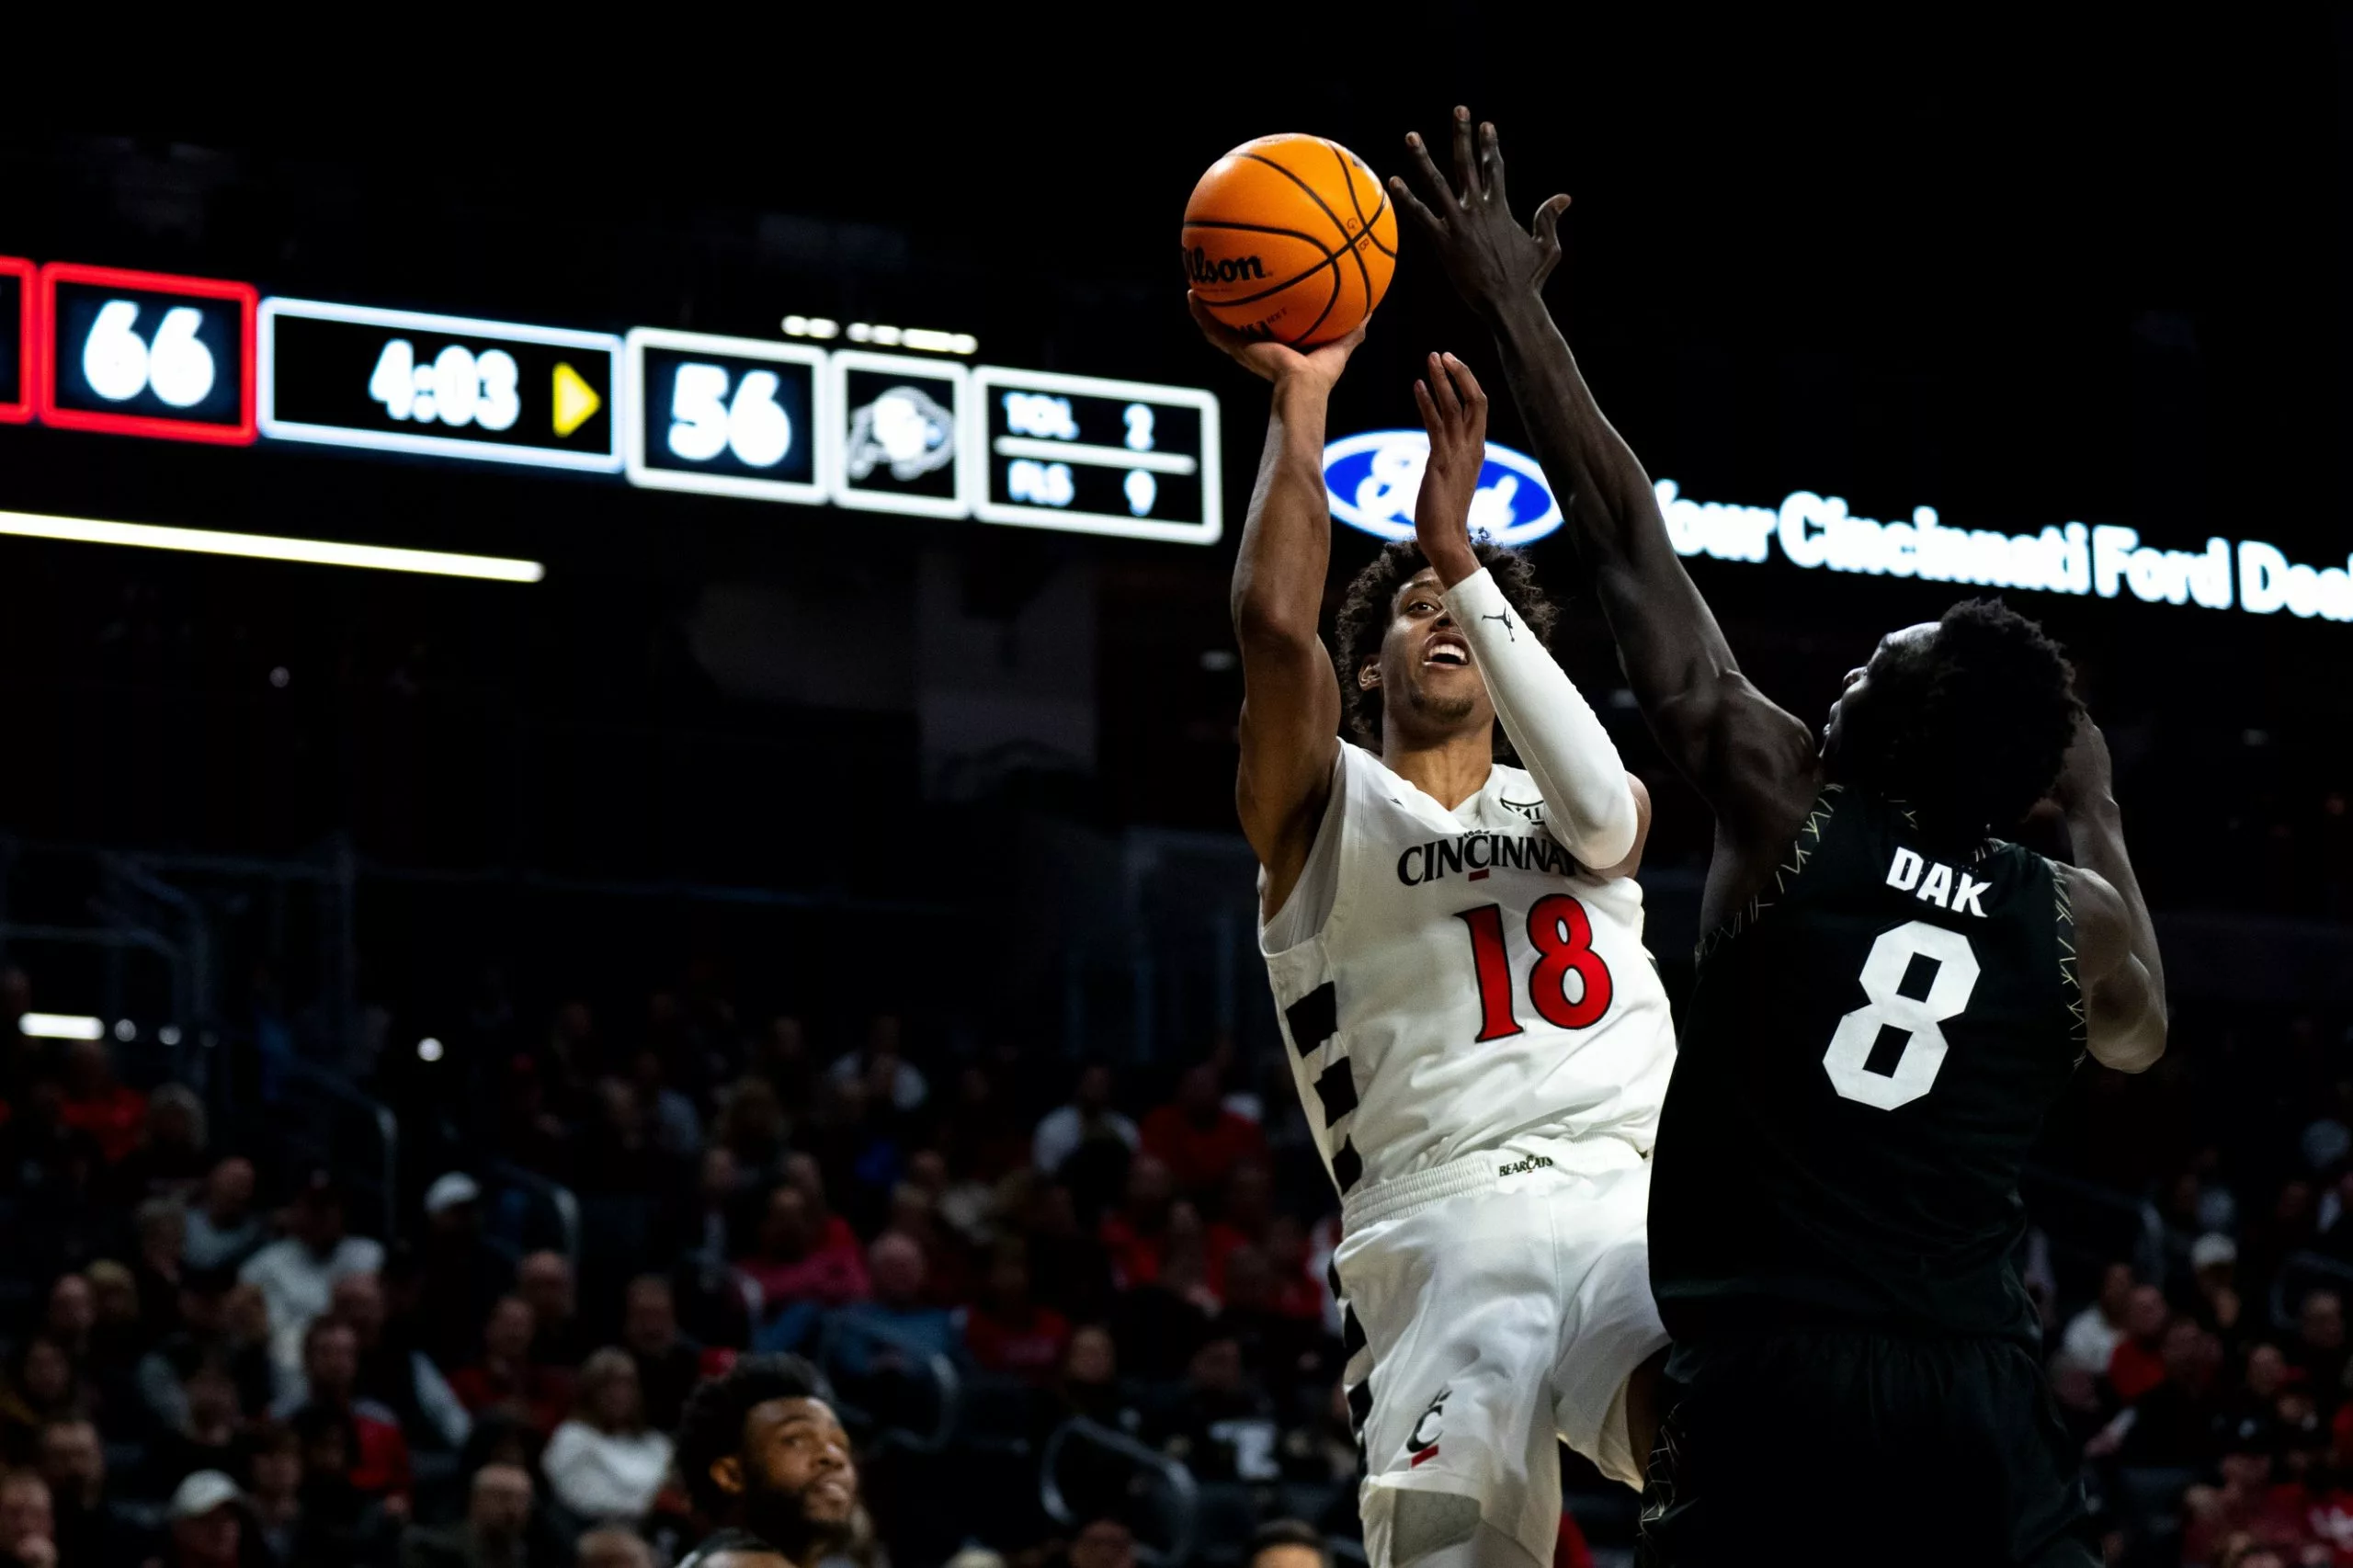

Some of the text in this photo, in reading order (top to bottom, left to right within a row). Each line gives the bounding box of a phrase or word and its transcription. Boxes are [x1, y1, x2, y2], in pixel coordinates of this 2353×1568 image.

[84, 301, 214, 407] 66
[369, 338, 520, 431] 4:03
[667, 361, 790, 468] 56
[1778, 492, 2091, 594] Cincinnati
[2093, 525, 2233, 609] Ford
[1396, 832, 1577, 887] CINCINNAT
[1885, 846, 1993, 917] DAK
[1452, 892, 1614, 1044] 18
[1822, 920, 1982, 1111] 8
[1499, 1154, 1554, 1177] BEARCATS
